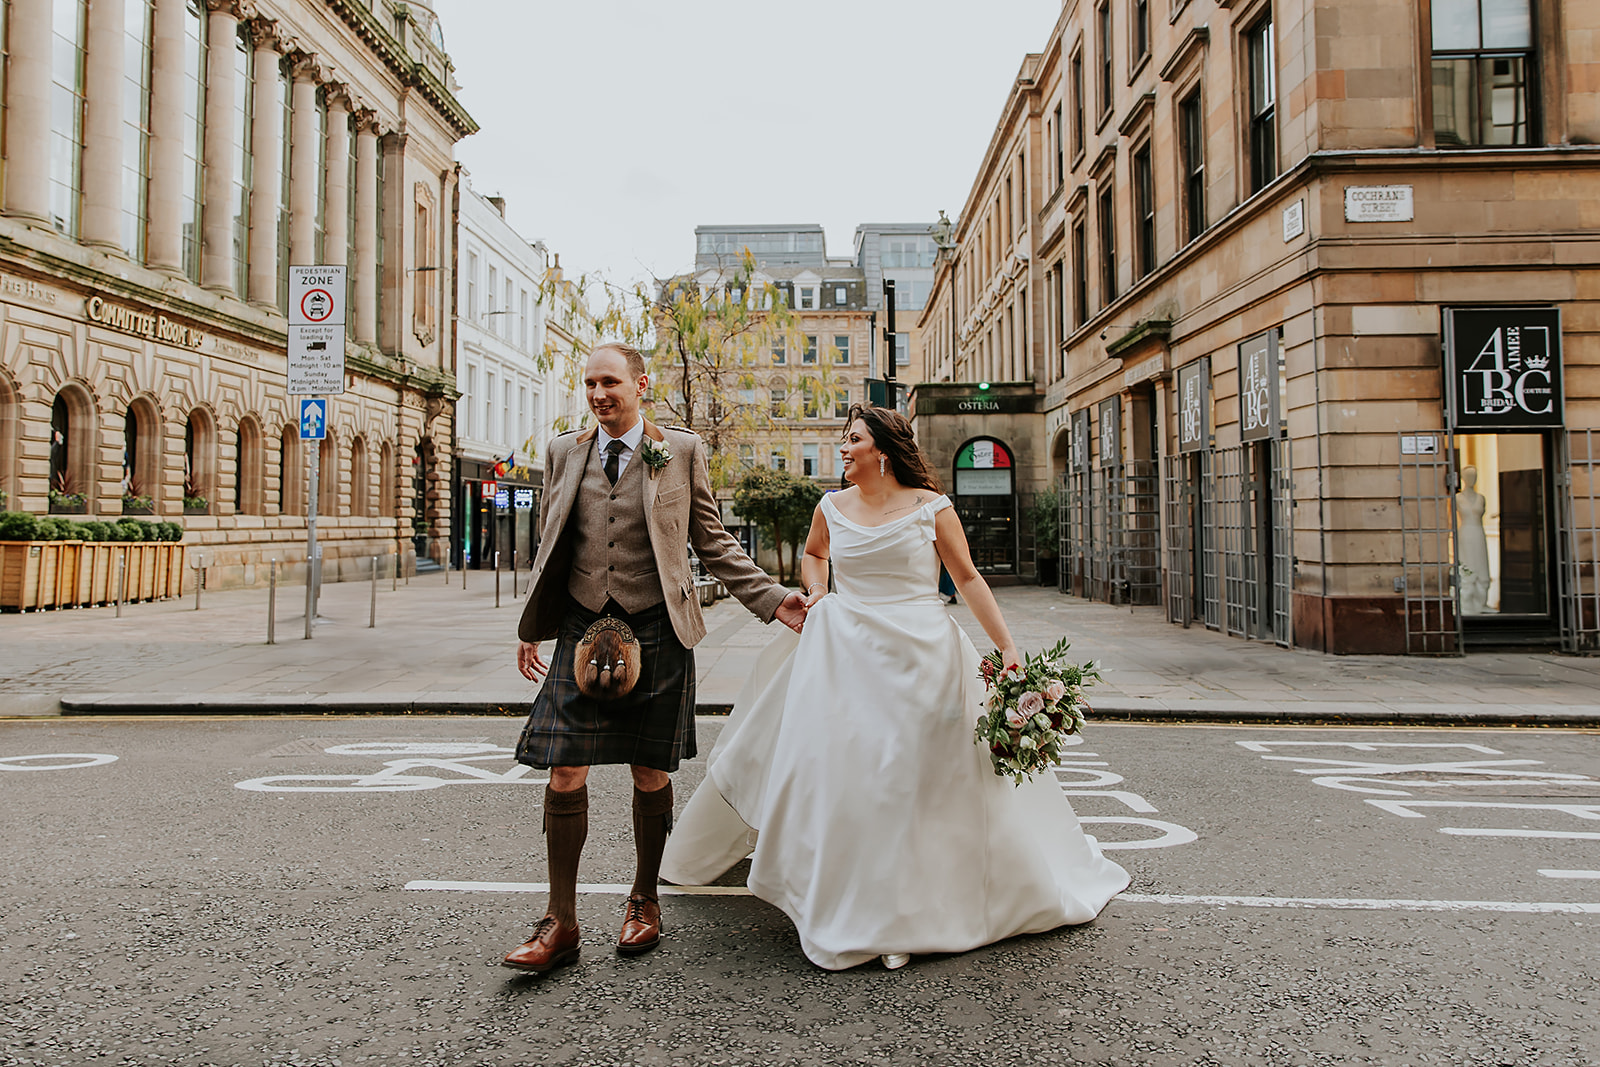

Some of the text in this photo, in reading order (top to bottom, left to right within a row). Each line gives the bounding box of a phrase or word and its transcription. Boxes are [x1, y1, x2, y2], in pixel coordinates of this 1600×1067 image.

[1351, 191, 1406, 201] COCHRANE
[1361, 203, 1396, 213] STREET
[301, 276, 334, 285] ZONE
[88, 296, 156, 337] COMMITTEE
[158, 315, 187, 344] ROOM
[1507, 326, 1521, 372] AIMEE
[958, 401, 1000, 410] OSTERIA
[1481, 398, 1517, 407] BRIDAL
